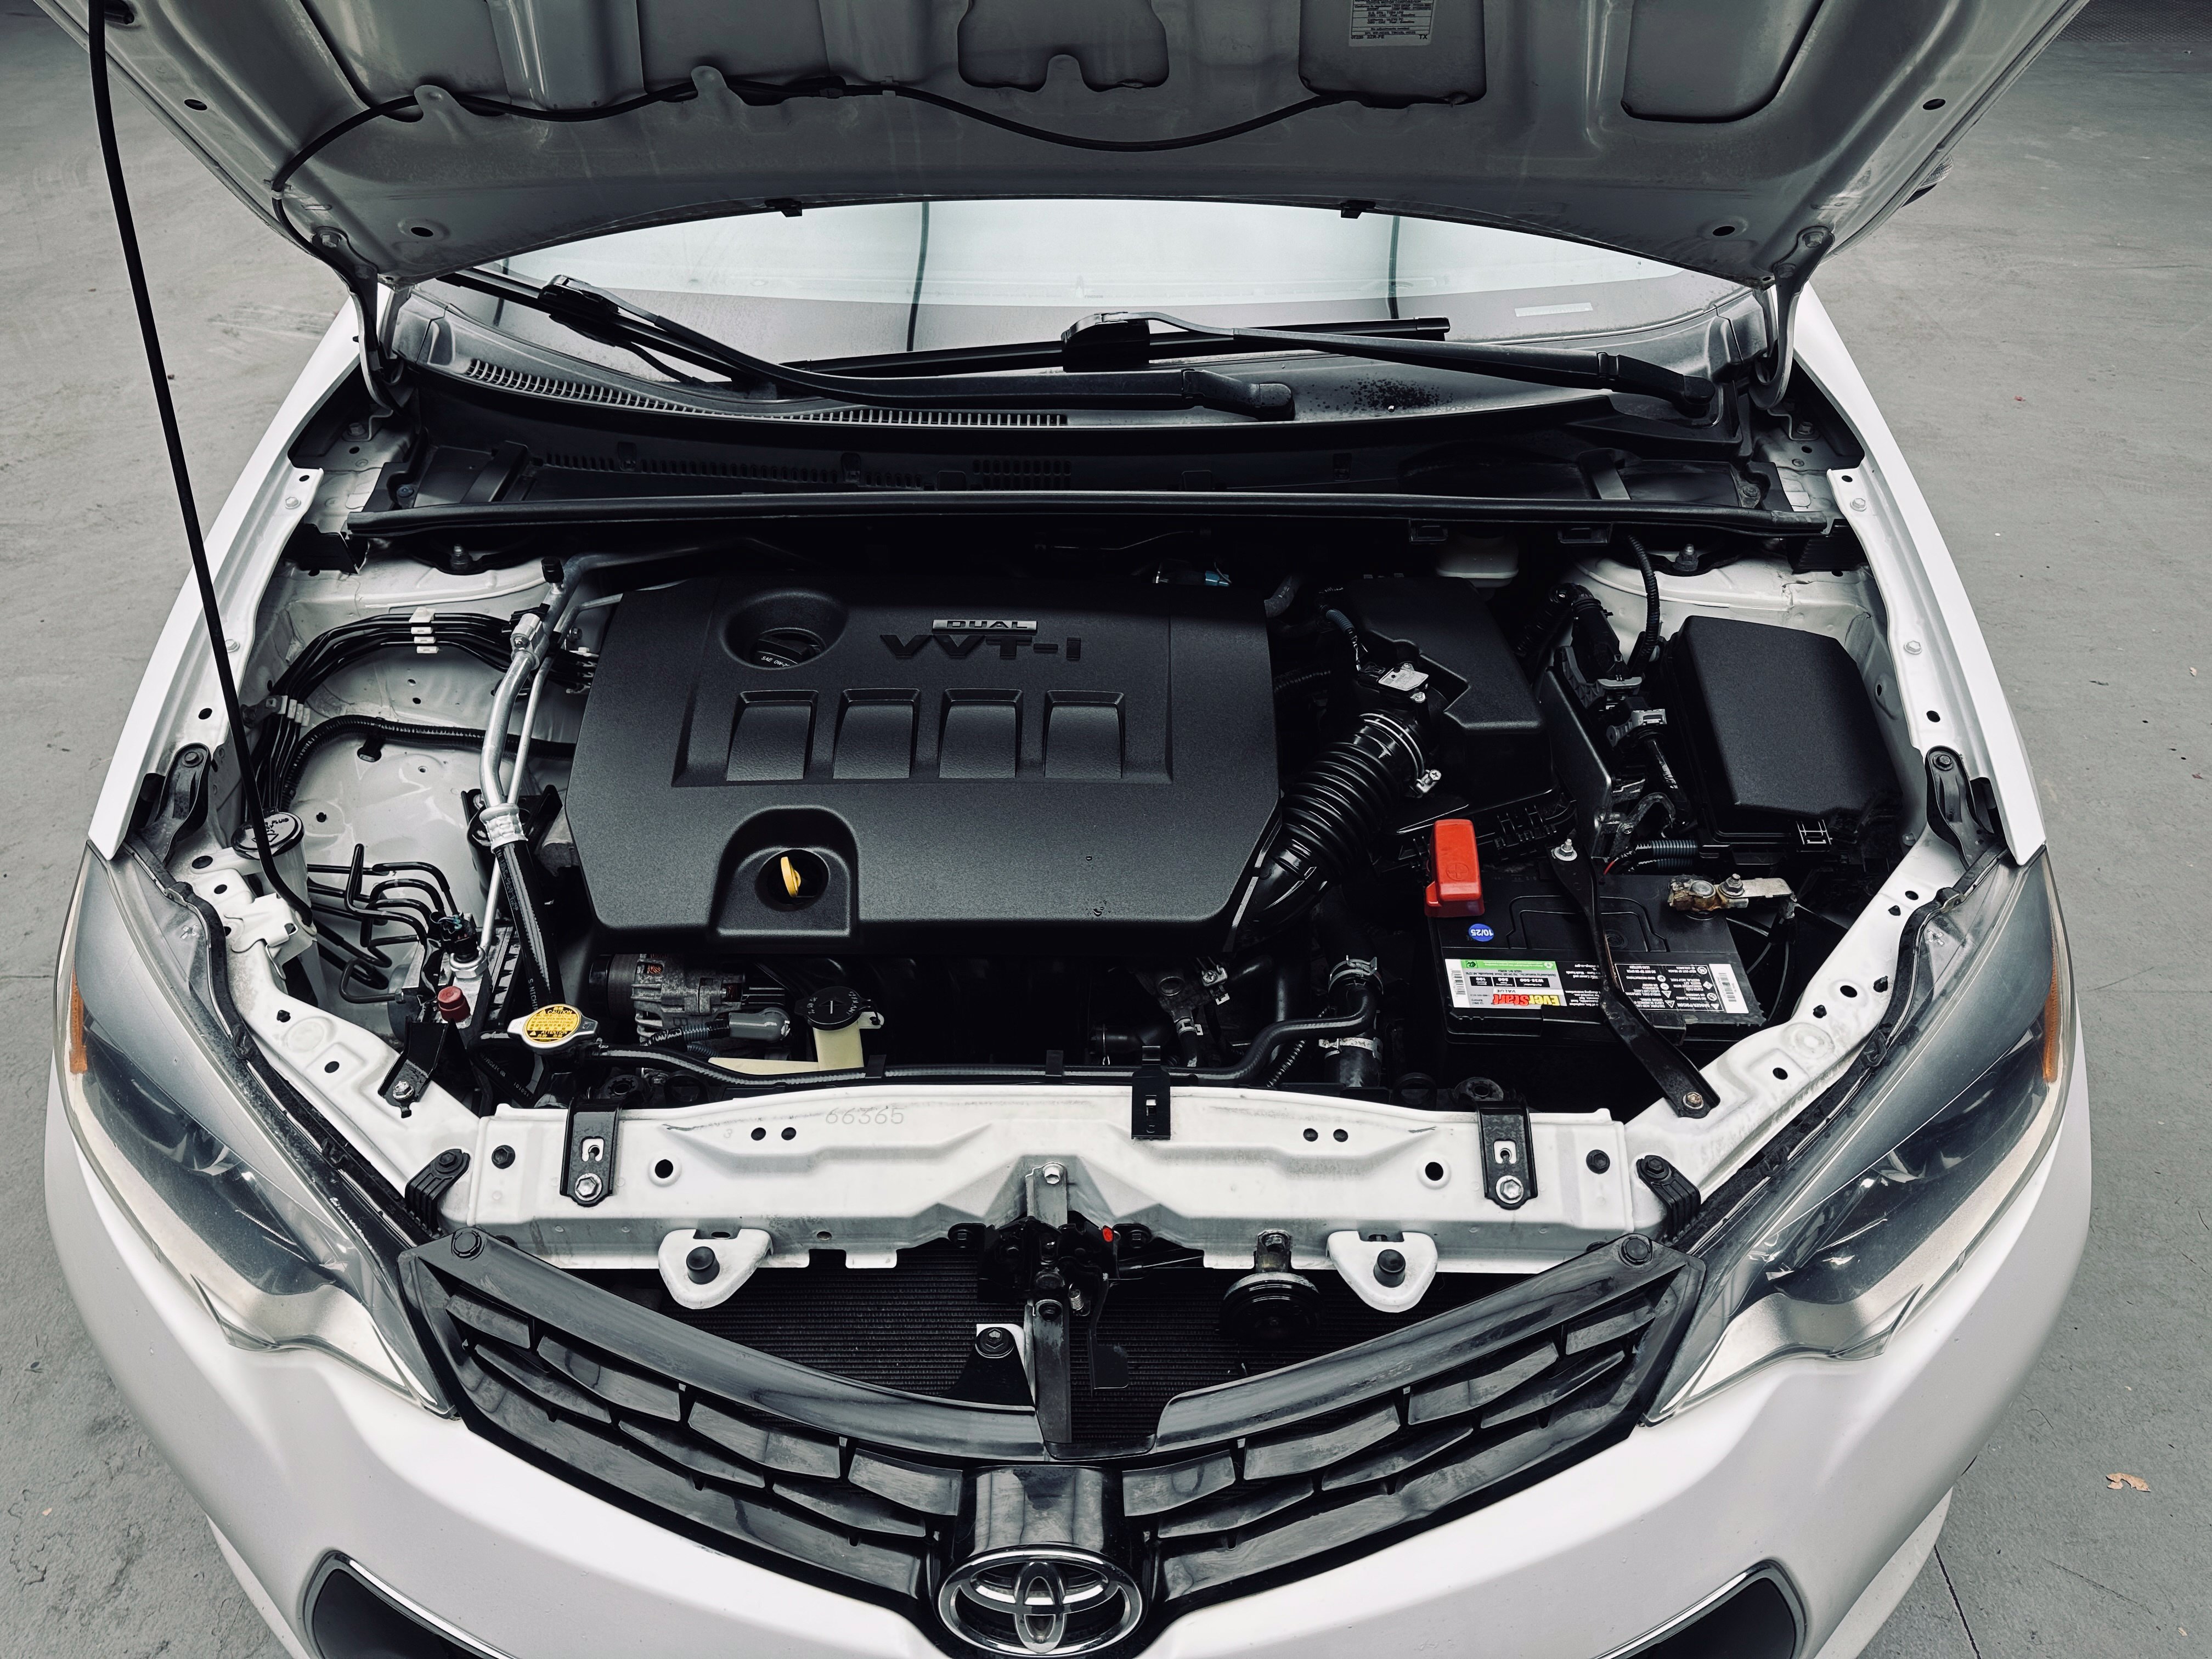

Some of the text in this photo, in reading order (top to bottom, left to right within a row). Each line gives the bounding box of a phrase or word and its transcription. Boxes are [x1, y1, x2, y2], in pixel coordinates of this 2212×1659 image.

[946, 620, 1028, 629] DUAL
[1492, 994, 1561, 1006] EverStart
[825, 1107, 905, 1125] 66365
